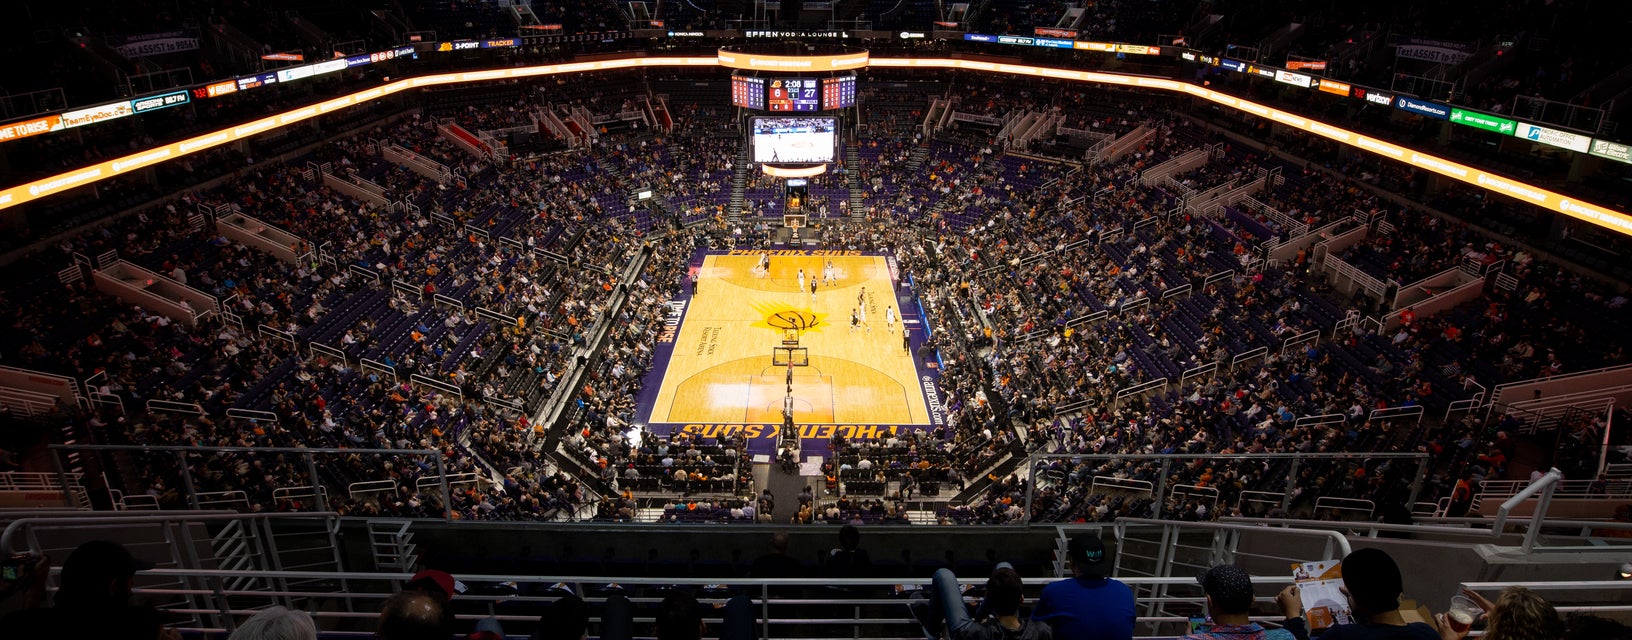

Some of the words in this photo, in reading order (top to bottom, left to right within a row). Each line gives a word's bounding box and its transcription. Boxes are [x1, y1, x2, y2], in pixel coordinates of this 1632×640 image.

[139, 43, 165, 54] ASSIST
[455, 42, 479, 50] 3-POINT
[1413, 49, 1440, 60] ASSIST
[785, 80, 801, 88] 2:08
[774, 89, 781, 97] 6
[804, 89, 816, 97] 27
[1366, 92, 1390, 105] verizon
[14, 124, 28, 136] TO
[27, 120, 49, 134] RISE
[1540, 135, 1572, 146] AUTOMATION
[1559, 131, 1576, 140] OFFICE
[1606, 149, 1630, 160] Electric
[680, 424, 762, 438] SUNS
